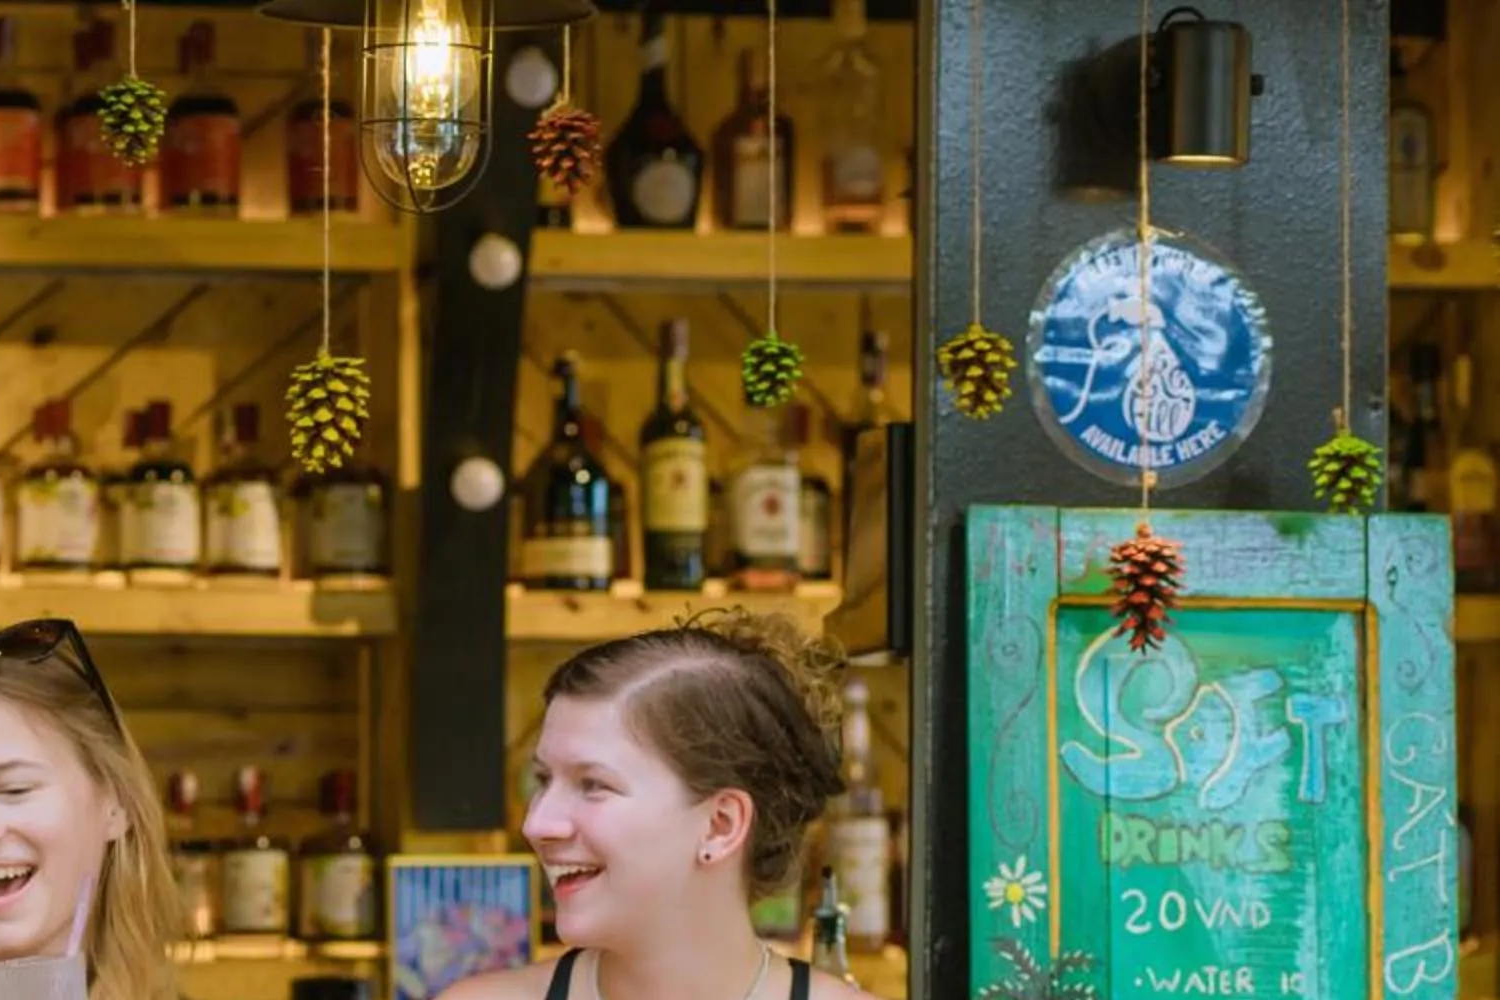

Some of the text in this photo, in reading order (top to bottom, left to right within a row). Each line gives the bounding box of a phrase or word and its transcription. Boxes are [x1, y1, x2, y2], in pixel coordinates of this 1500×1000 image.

[1176, 420, 1227, 461] HERE
[1061, 622, 1348, 810] SOFT
[1121, 888, 1271, 934] 20 VND
[1146, 966, 1254, 995] WATER
